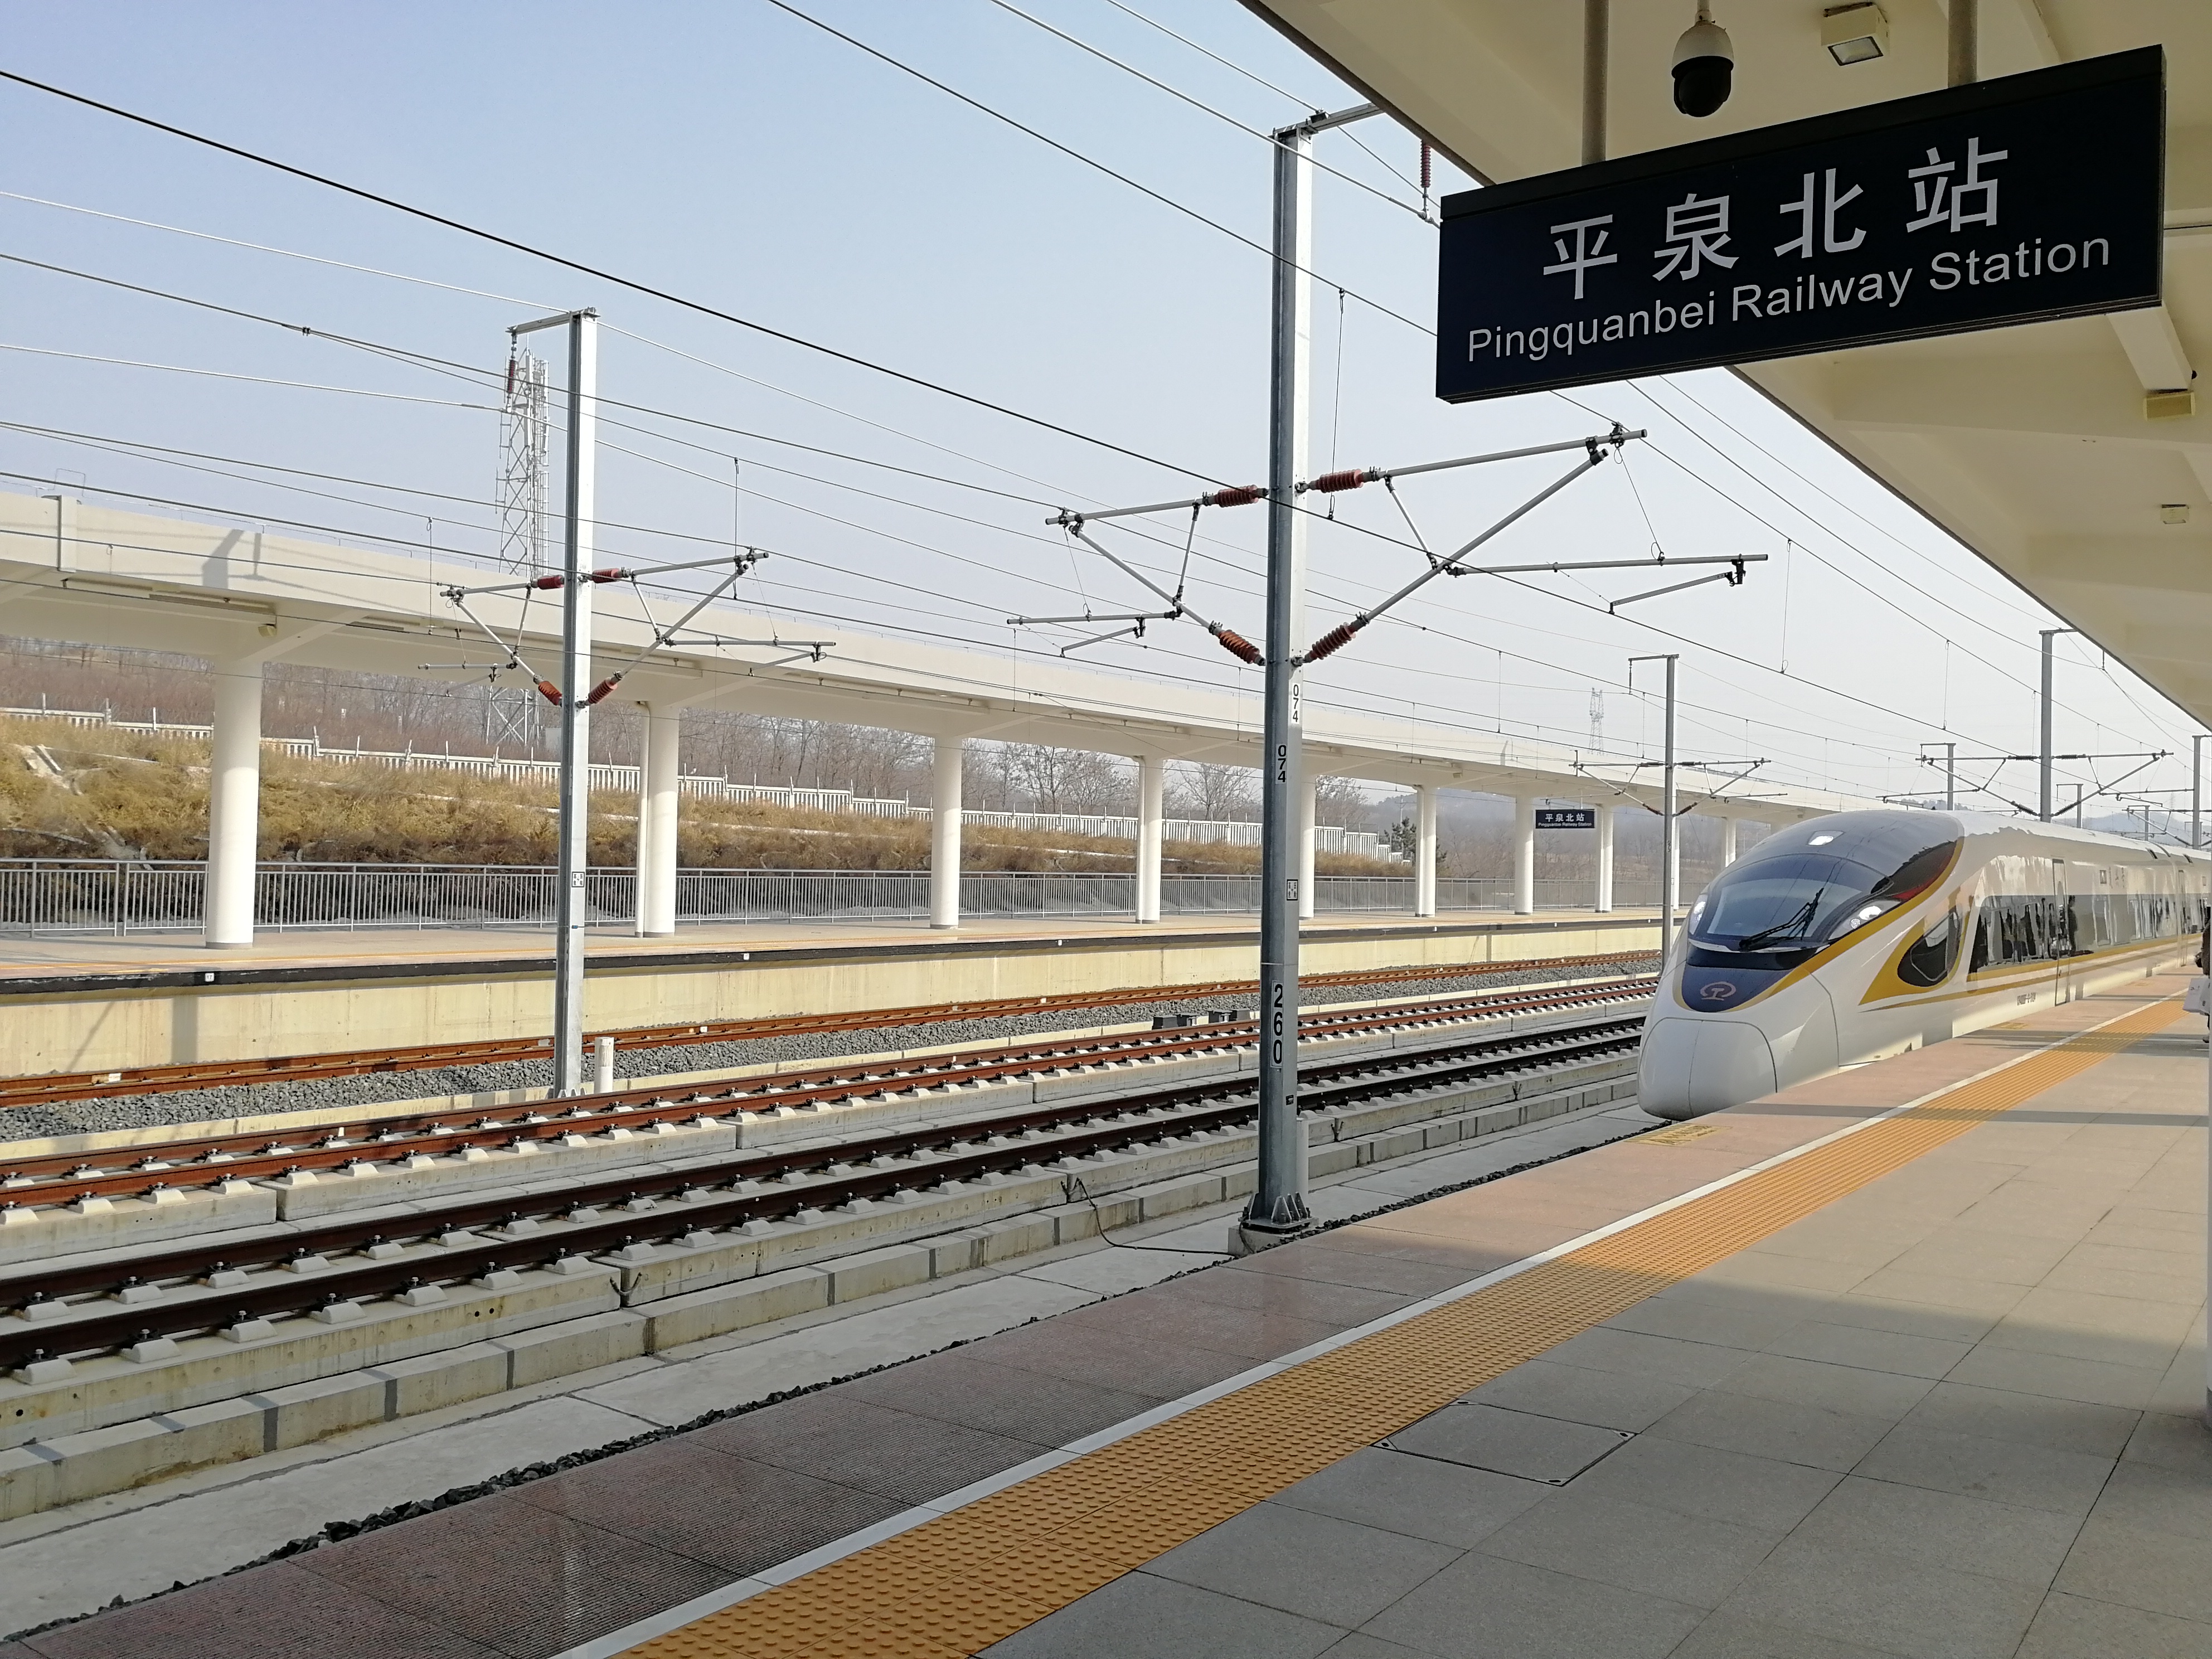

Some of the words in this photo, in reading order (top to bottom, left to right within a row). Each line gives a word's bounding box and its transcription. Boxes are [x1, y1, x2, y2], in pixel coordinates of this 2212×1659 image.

[1542, 136, 2009, 300] 平泉北站
[1468, 291, 1715, 362] Pingquanbei
[1732, 268, 1913, 322] Railway
[1929, 237, 2109, 290] Station
[1277, 744, 1287, 783] 074
[1545, 813, 1585, 822] 平泉北站
[1273, 983, 1283, 1064] 260
